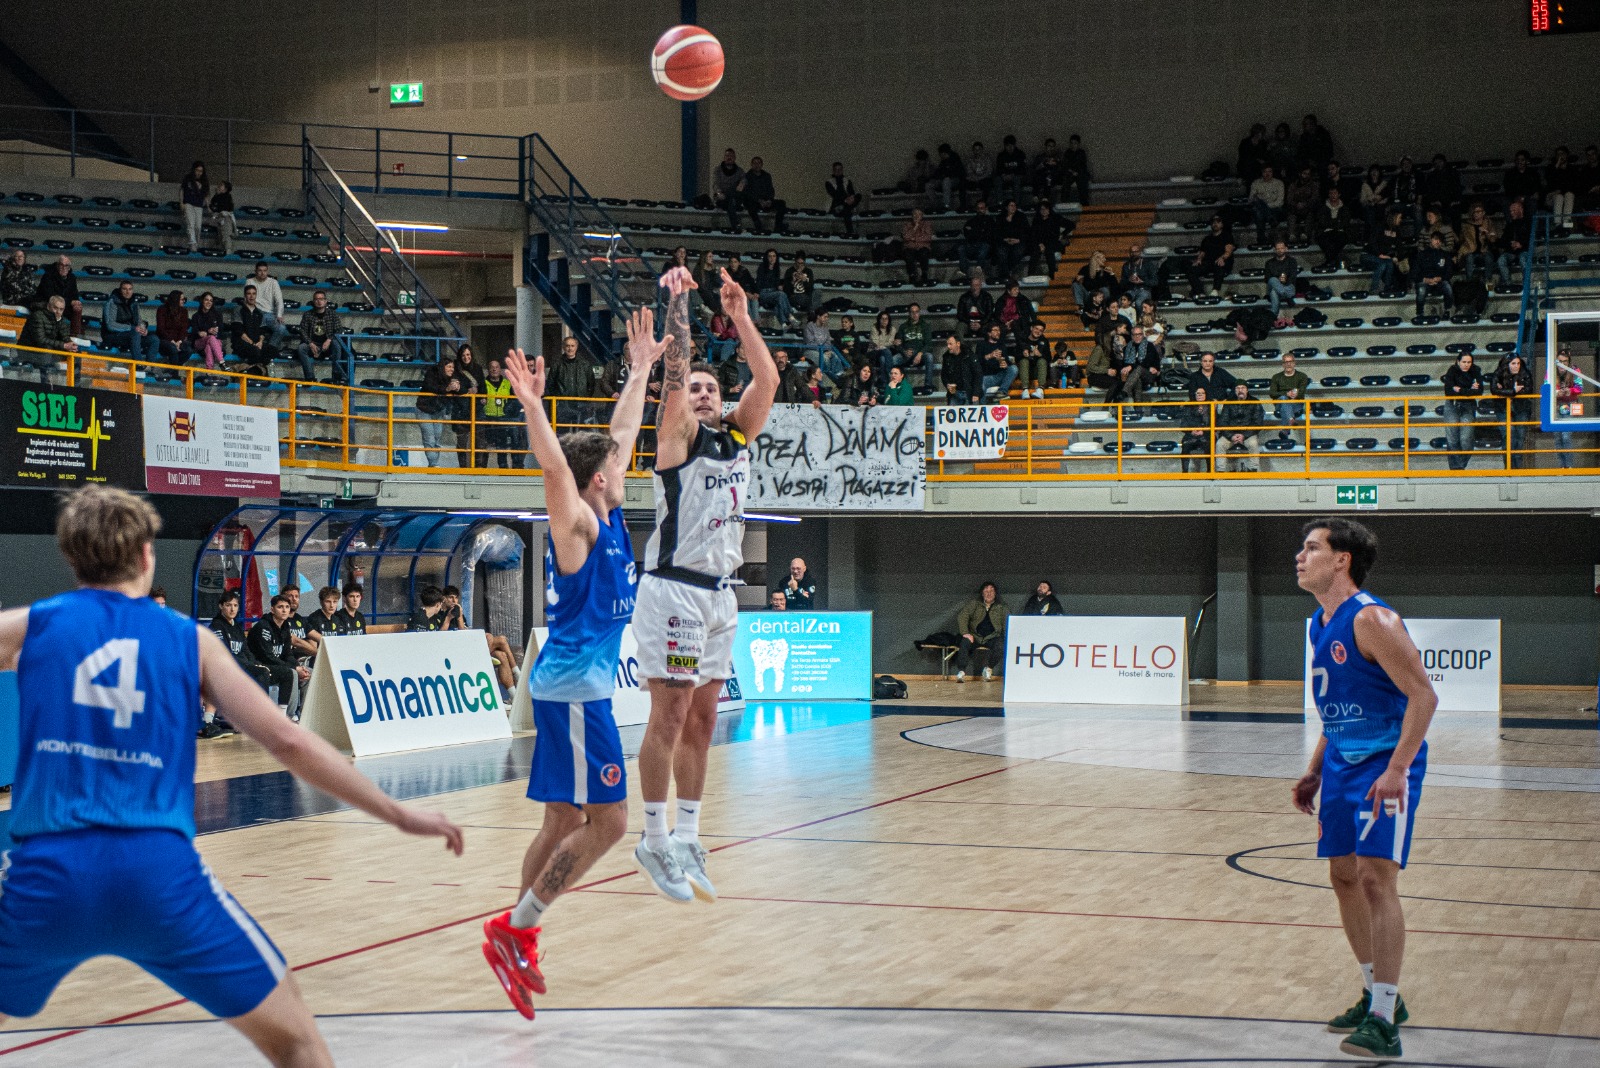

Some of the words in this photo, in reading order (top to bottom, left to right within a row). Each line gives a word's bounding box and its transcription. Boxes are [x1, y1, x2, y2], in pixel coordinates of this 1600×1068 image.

[938, 406, 988, 425] FORZA
[750, 618, 840, 634] dentalZen
[1015, 643, 1176, 669] HOTELLO
[1418, 649, 1492, 670] OCOOP
[72, 638, 146, 729] 4
[340, 658, 498, 724] Dinamica
[1358, 811, 1376, 841] 7
